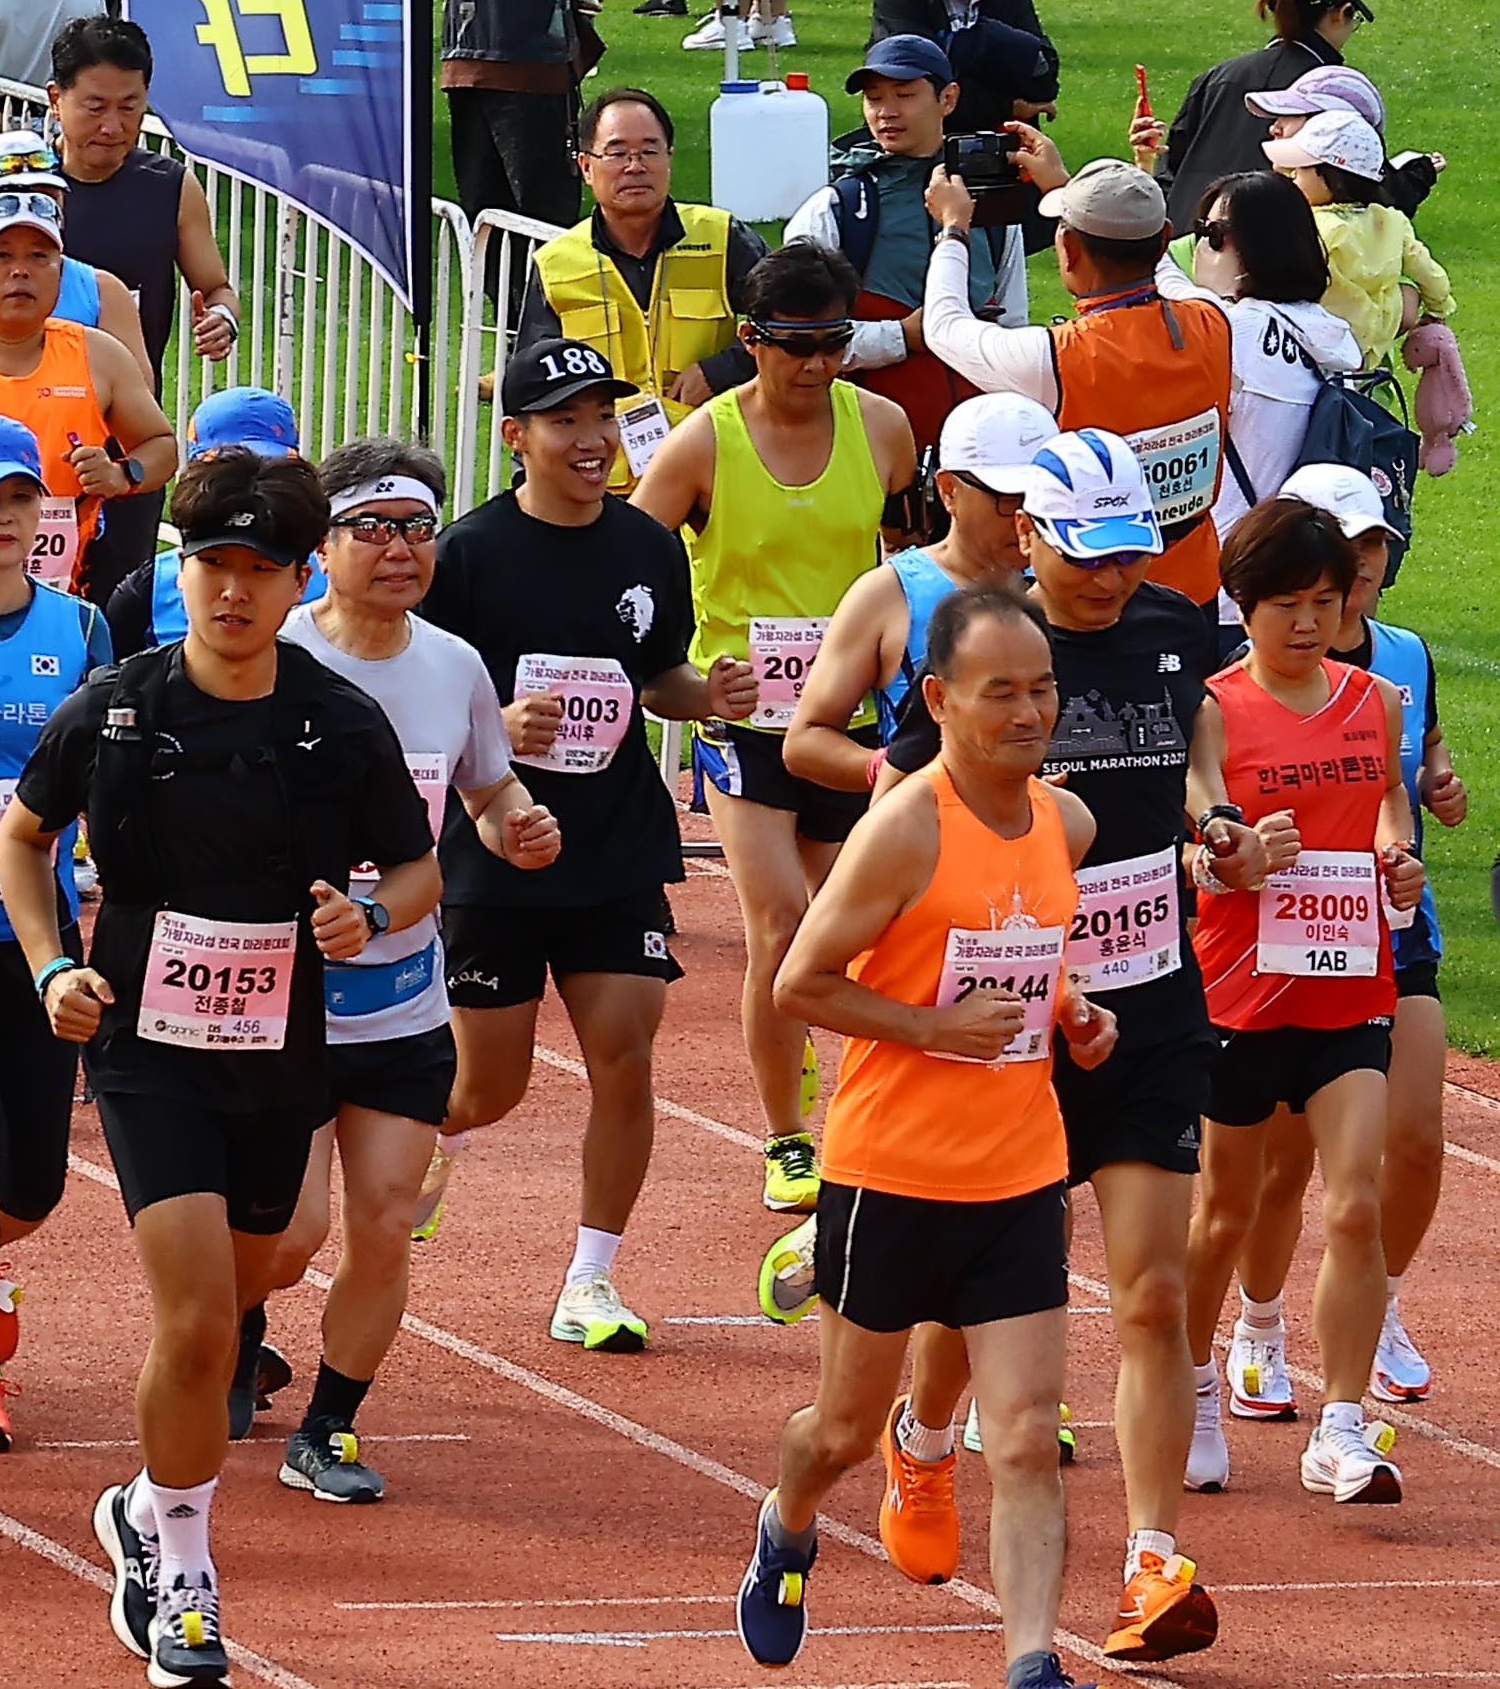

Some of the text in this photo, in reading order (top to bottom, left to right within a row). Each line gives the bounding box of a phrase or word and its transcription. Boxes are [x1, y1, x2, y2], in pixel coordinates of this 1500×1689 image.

[539, 347, 606, 381] 188
[1042, 755, 1088, 775] SEOUL
[1090, 755, 1161, 771] MARATHON
[1274, 893, 1369, 922] 28009
[1067, 893, 1169, 948] 20165
[161, 926, 217, 953] 가평자라섬
[218, 936, 241, 951] 전국
[1305, 923, 1349, 942] 이인숙
[954, 945, 1003, 959] 가평자라섬
[1001, 944, 1023, 959] 전국
[1305, 949, 1348, 972] 1AB
[161, 958, 277, 995] 20153
[1101, 959, 1130, 976] 440
[194, 994, 247, 1016] 전종철
[232, 1019, 261, 1034] 456
